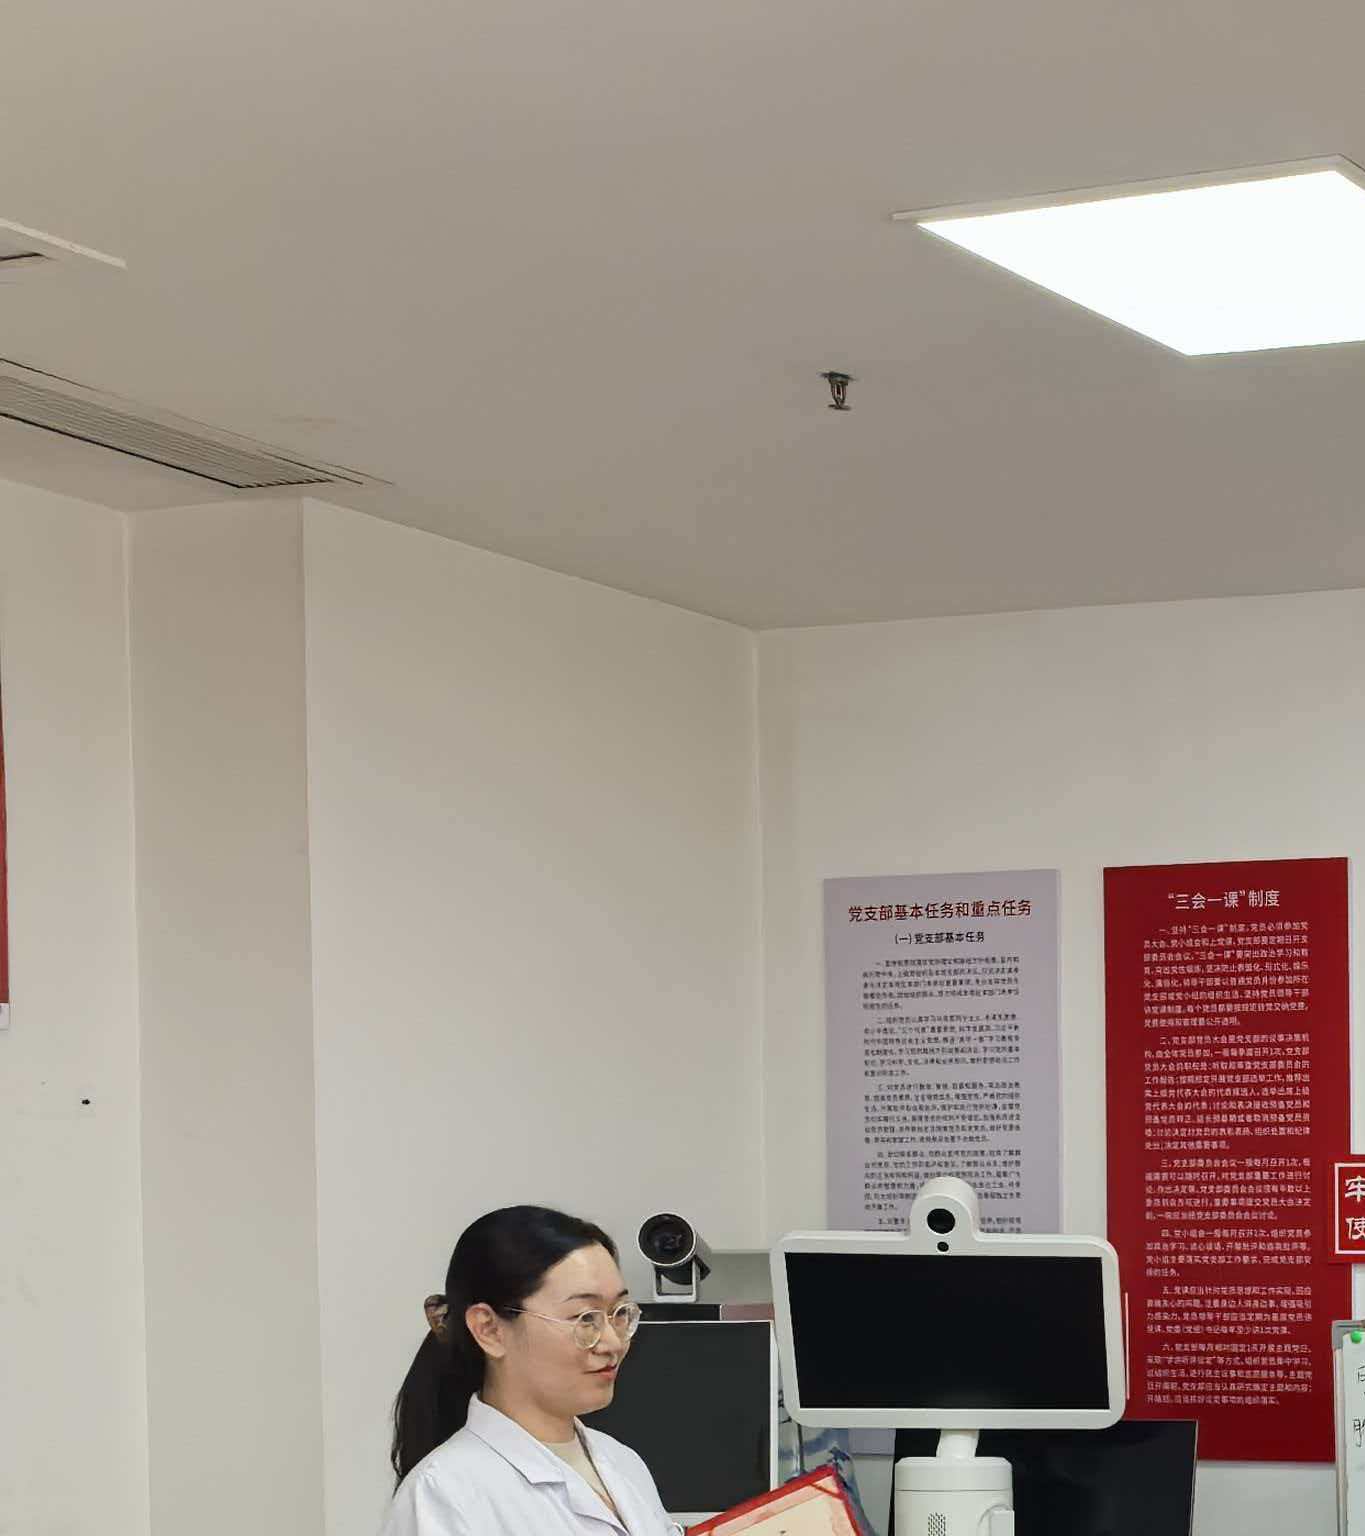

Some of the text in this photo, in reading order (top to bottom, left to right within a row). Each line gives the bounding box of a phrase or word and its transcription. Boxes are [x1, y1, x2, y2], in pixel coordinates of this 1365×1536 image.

[848, 898, 1033, 923] 党支部基本任务和重点任务
